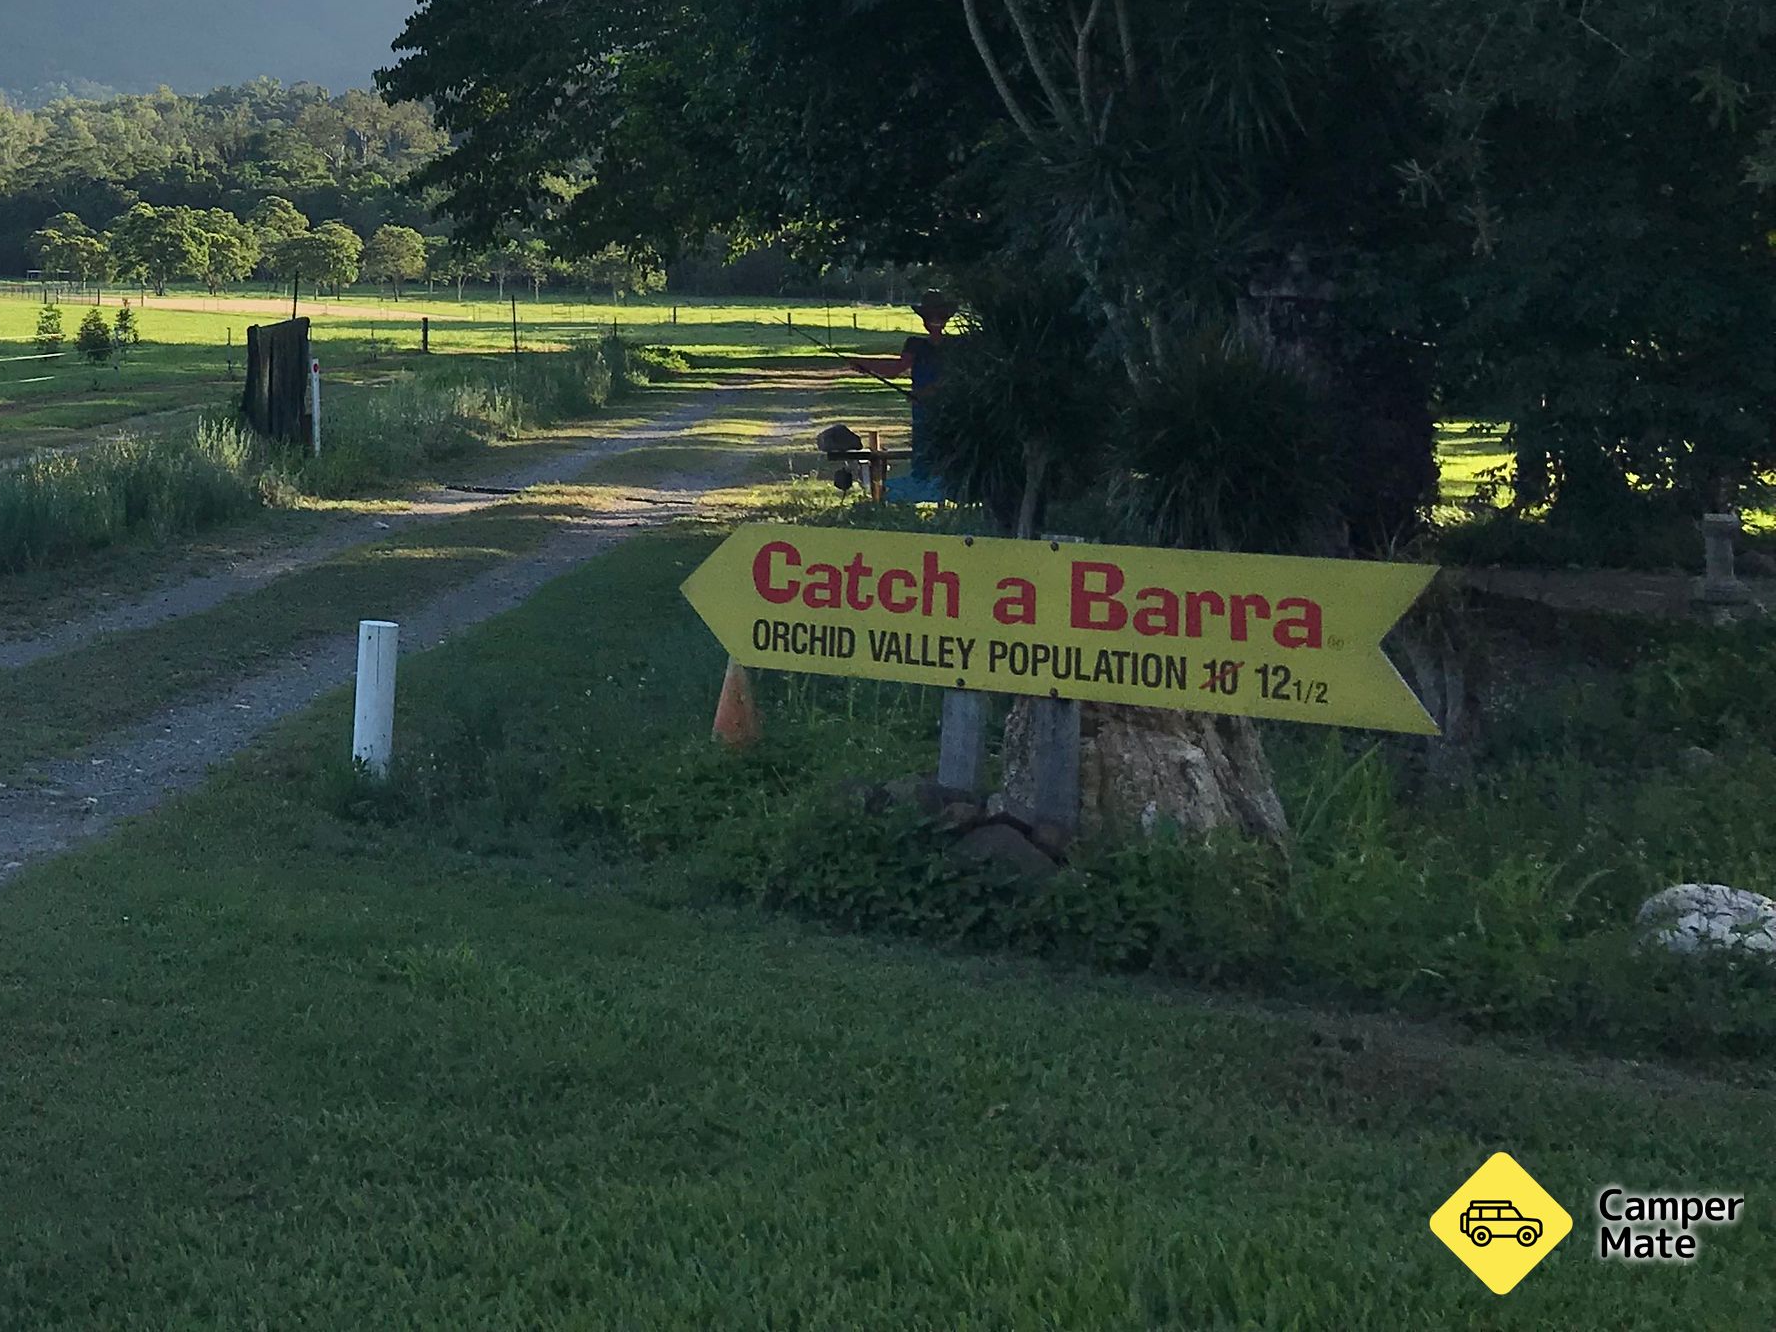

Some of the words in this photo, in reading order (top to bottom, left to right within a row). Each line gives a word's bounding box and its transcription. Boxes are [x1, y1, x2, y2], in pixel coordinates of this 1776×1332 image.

[752, 541, 961, 619] Catch
[992, 576, 1037, 626] a
[1070, 561, 1323, 649] Barra
[752, 619, 856, 659] ORCHID
[868, 629, 976, 670] VALLEY
[987, 640, 1187, 691] POPULATION
